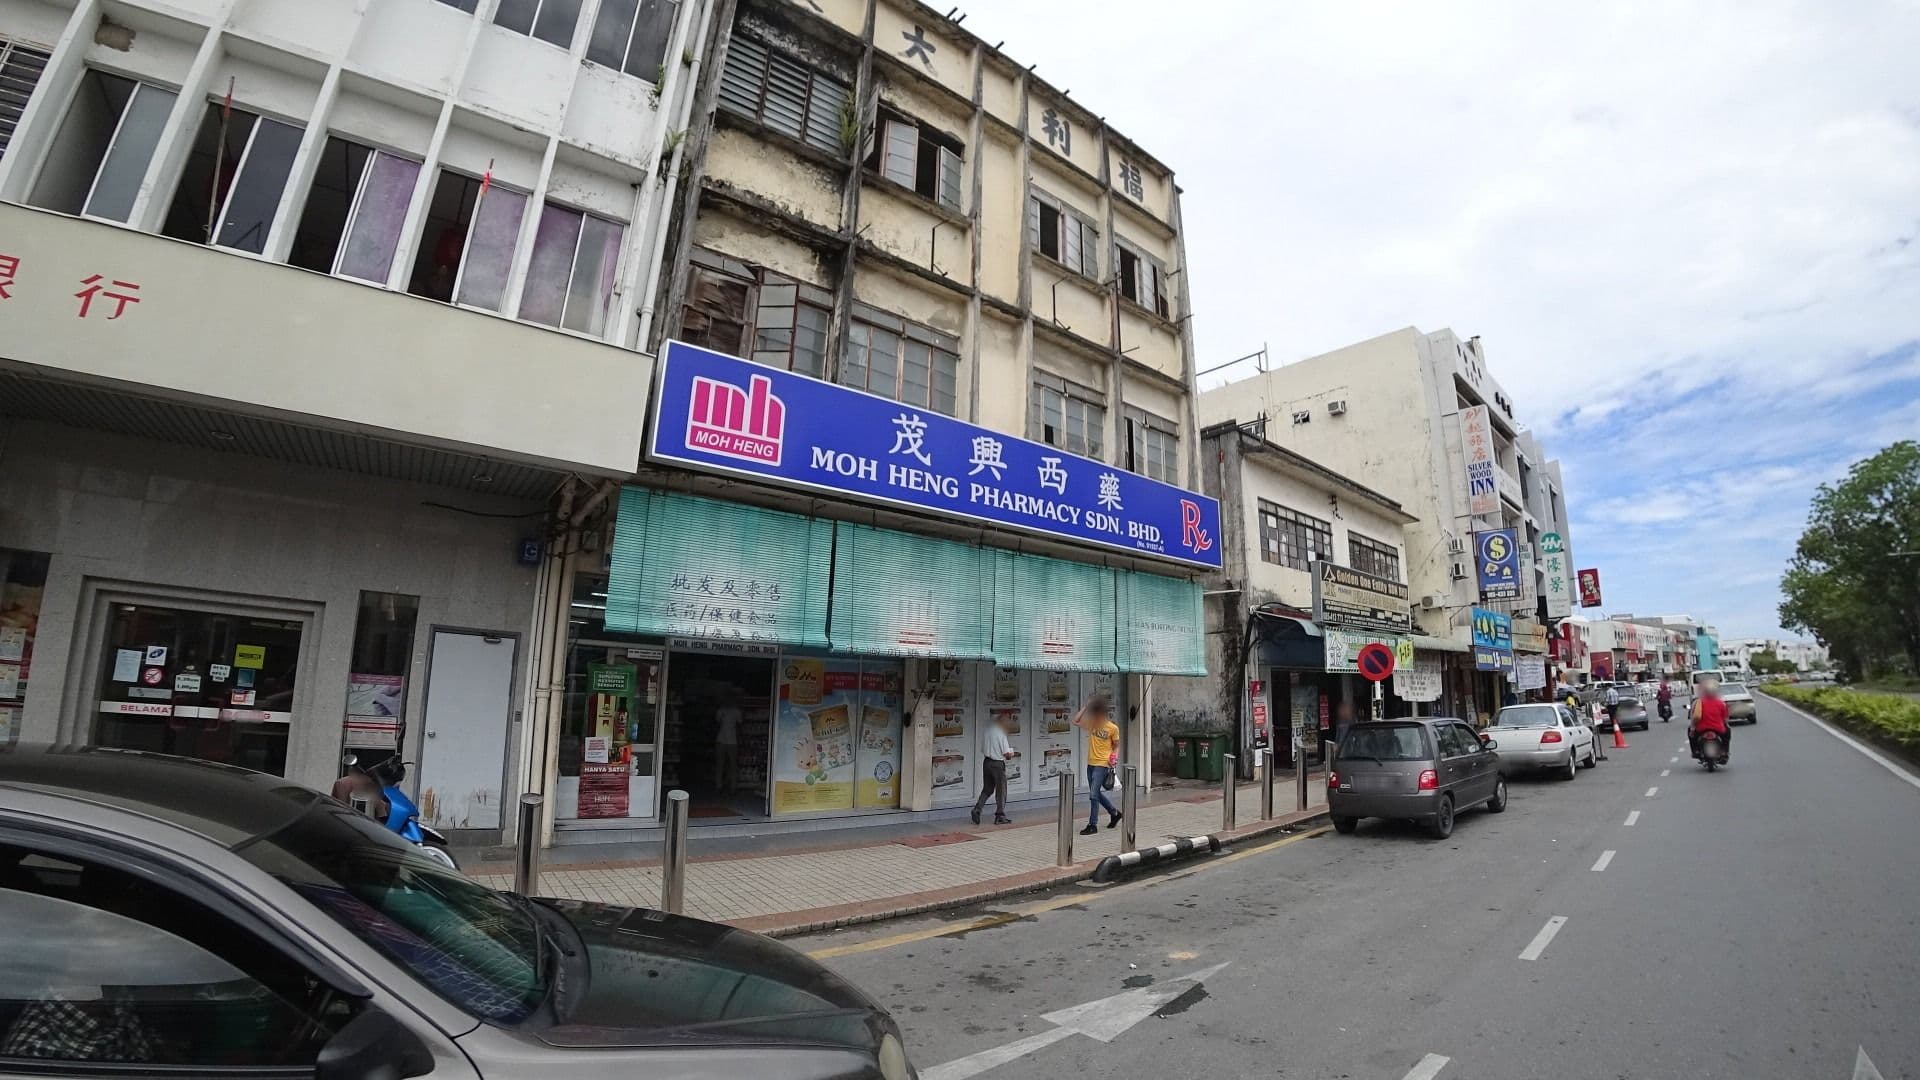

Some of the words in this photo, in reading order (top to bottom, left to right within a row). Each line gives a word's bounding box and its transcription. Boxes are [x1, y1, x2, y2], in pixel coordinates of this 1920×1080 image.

[695, 431, 721, 449] MOH
[732, 438, 774, 457] HENG
[1467, 461, 1493, 472] SILVER
[1470, 470, 1492, 480] WOOD
[810, 446, 878, 482] MOH
[888, 463, 959, 498] HENG
[970, 483, 1081, 525] PHARMACY
[1085, 510, 1124, 536] SDN.
[1128, 520, 1164, 545] BHD.
[1471, 478, 1495, 496] INN
